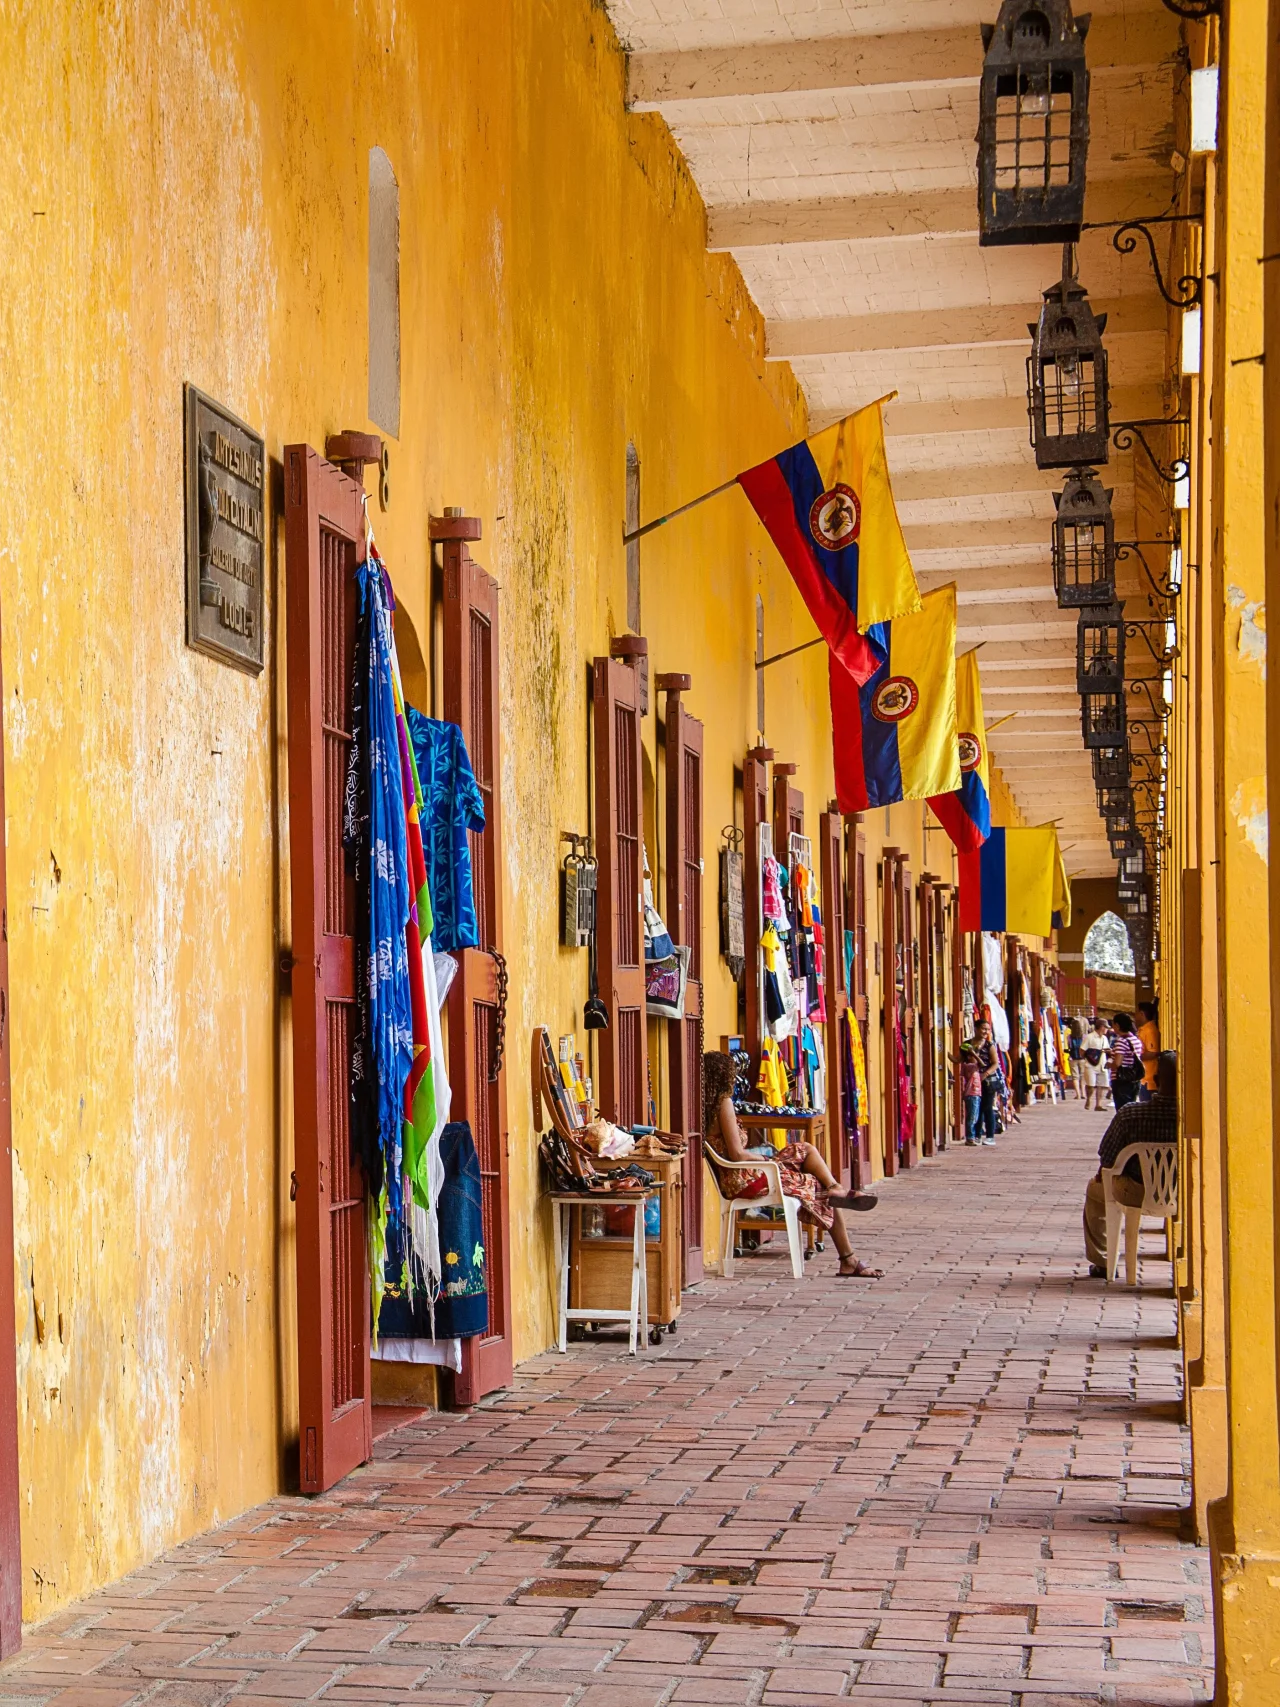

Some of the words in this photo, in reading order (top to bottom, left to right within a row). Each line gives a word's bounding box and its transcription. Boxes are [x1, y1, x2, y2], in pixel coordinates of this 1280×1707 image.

[215, 430, 262, 489] ARTESANIAS
[379, 440, 390, 513] 8
[231, 494, 263, 541] CATALIN
[225, 596, 248, 636] LOCAL
